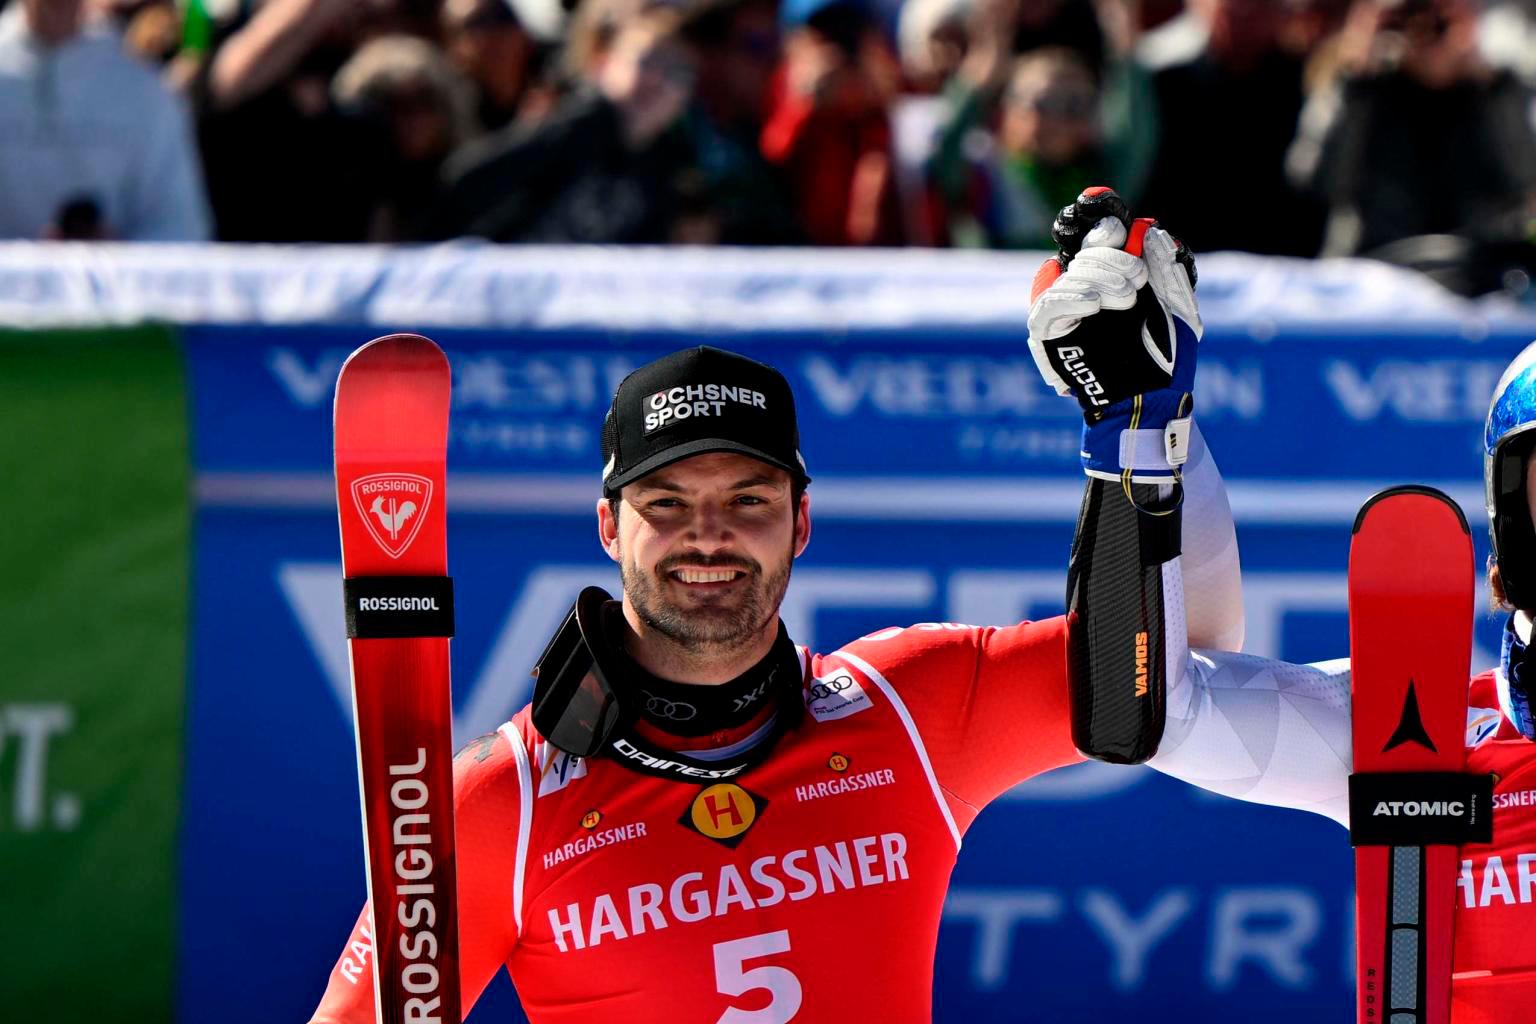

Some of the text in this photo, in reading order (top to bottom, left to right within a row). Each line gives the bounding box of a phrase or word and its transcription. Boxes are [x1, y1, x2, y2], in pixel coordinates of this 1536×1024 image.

[1057, 346, 1110, 407] racing
[650, 384, 767, 410] OCHSNER
[645, 401, 726, 431] SPORT
[362, 481, 422, 495] ROSSIGNOL
[359, 597, 439, 611] ROSSIGNOL
[1135, 631, 1148, 697] VAMOS
[613, 738, 748, 779] DAINESE
[795, 768, 896, 802] HARGASSNER
[1372, 801, 1465, 816] ATOMIC
[543, 822, 647, 870] HARGASSNER
[547, 833, 909, 953] HARGASSNER
